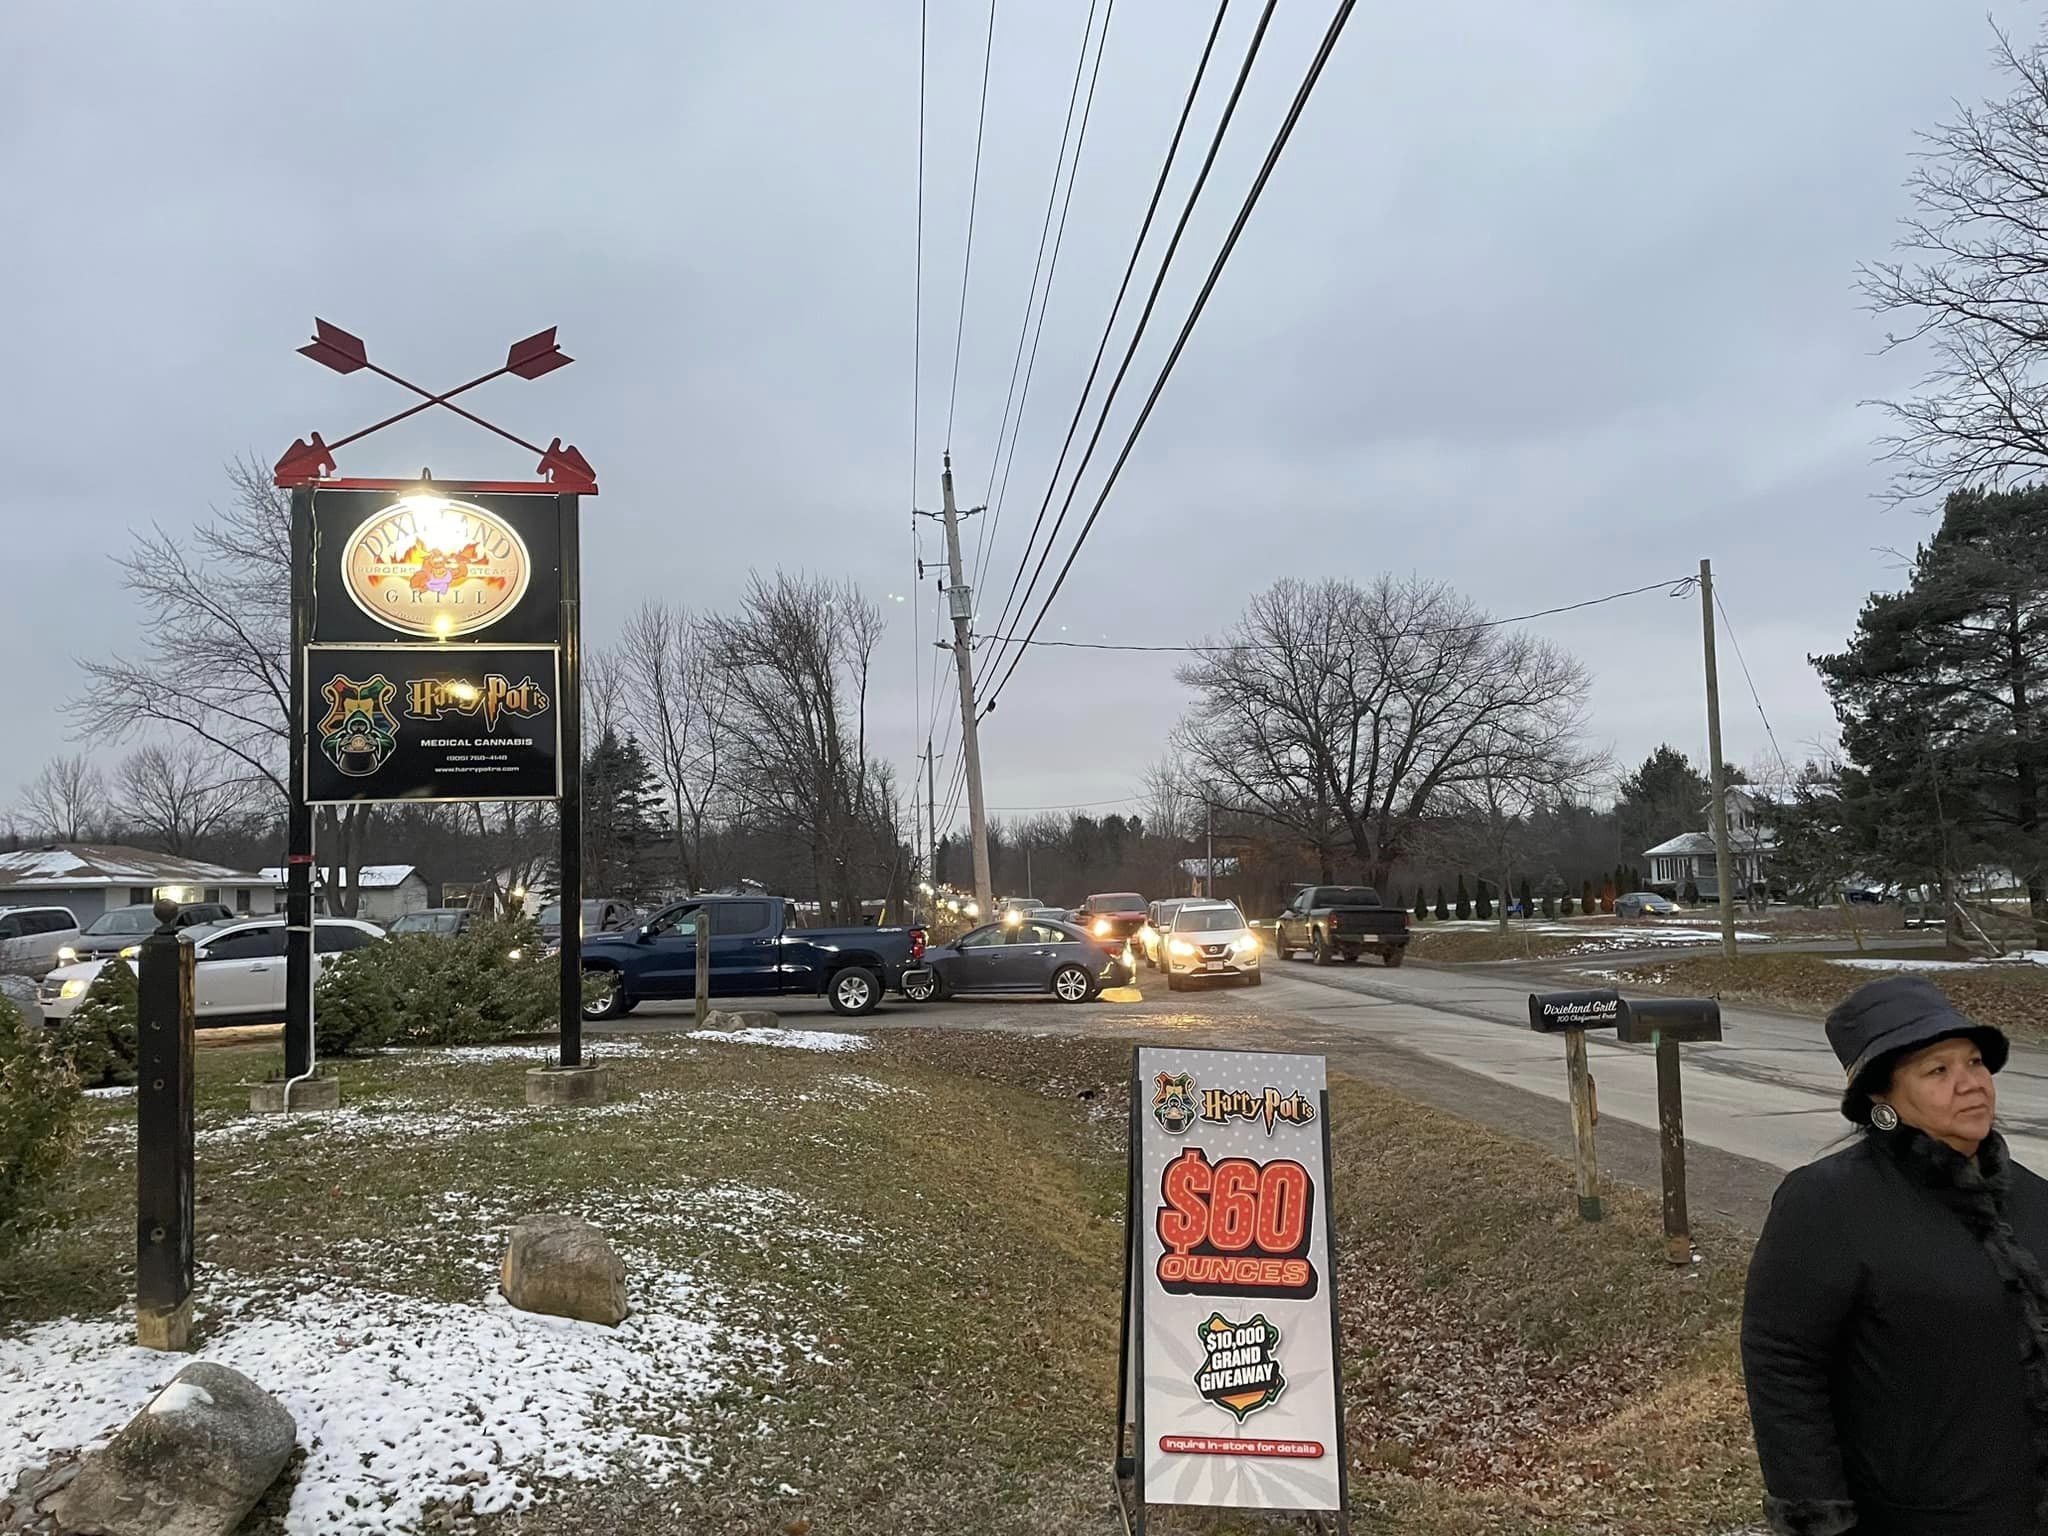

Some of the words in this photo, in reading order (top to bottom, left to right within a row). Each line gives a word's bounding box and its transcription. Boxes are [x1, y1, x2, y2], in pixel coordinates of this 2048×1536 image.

[360, 511, 512, 560] DIXIAND
[385, 589, 487, 604] GRILL
[420, 739, 472, 747] MEDICAL
[474, 738, 533, 746] CANNABIS
[1543, 1001, 1592, 1015] Dixieland
[1592, 1000, 1617, 1012] Grill
[1204, 1089, 1262, 1120] Harry
[1160, 1152, 1308, 1254] $60
[1160, 1256, 1309, 1285] OUNCES
[1207, 1325, 1266, 1352] $10,000
[1211, 1346, 1261, 1370] GRAND
[1200, 1363, 1274, 1391] GIVEAWAY
[1258, 1442, 1275, 1452] for
[1277, 1443, 1316, 1454] details
